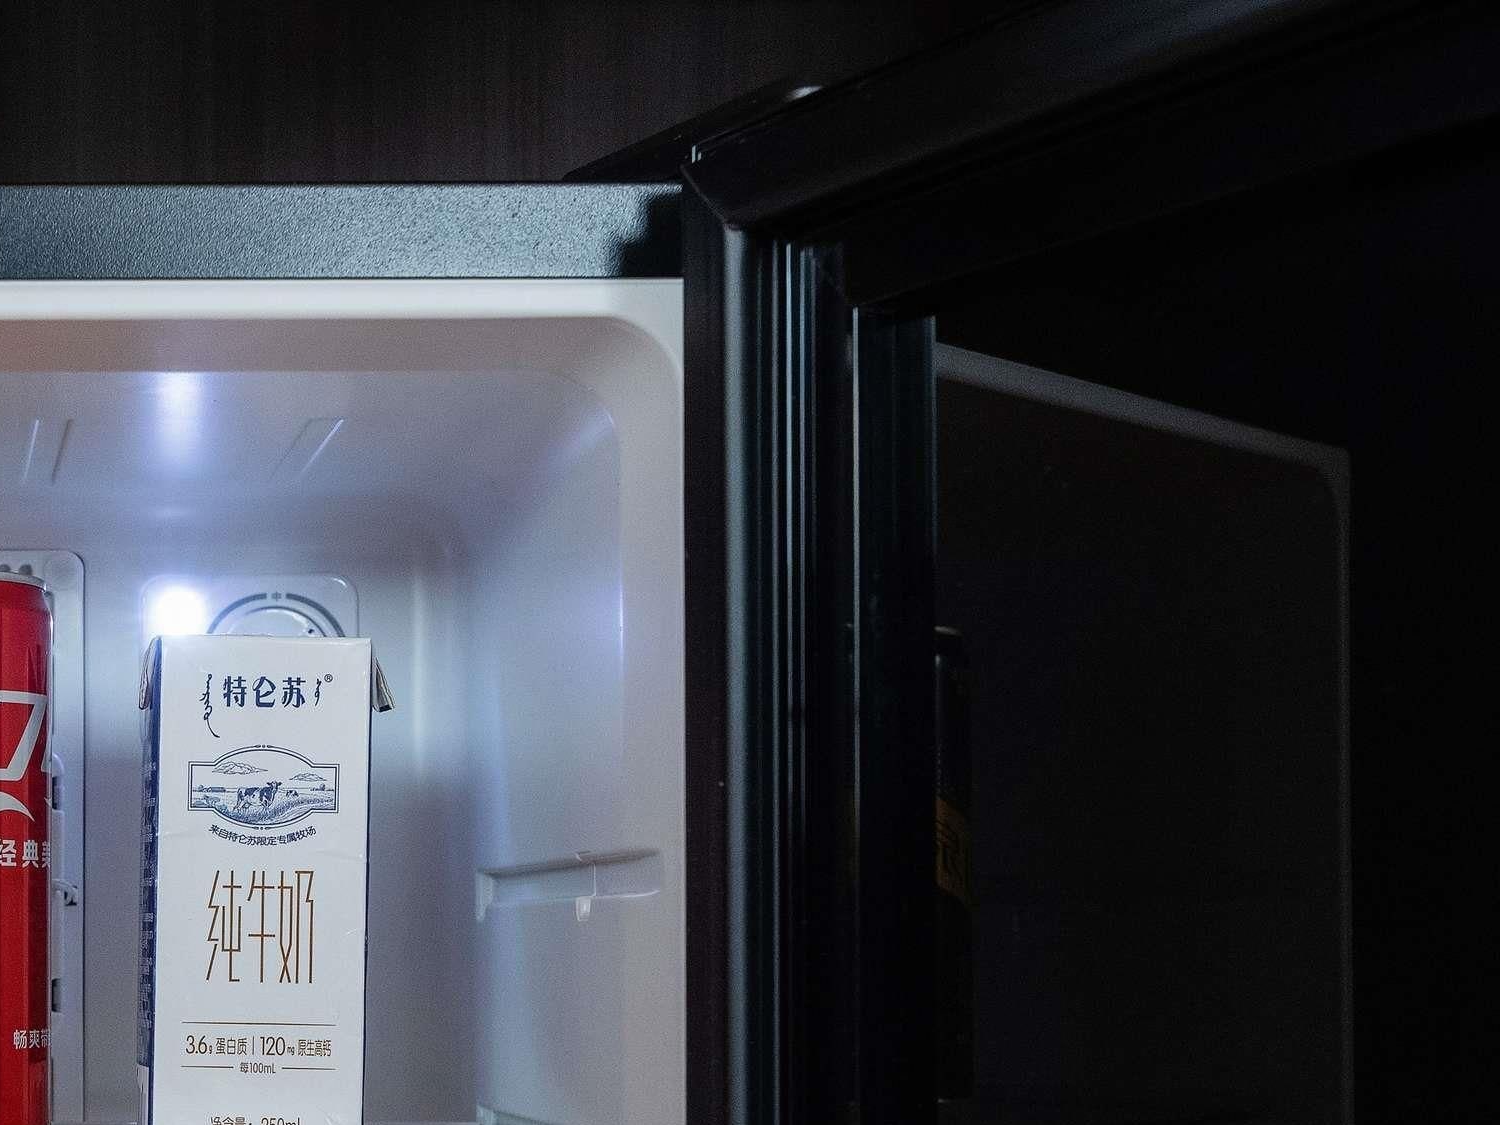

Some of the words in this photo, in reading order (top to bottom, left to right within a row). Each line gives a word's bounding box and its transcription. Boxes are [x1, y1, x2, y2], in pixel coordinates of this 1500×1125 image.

[223, 675, 307, 708] 特仑苏
[208, 824, 317, 846] 来自特仑苏限定专属牧场
[206, 870, 314, 984] 纯牛奶
[215, 1037, 248, 1056] 蛋白质
